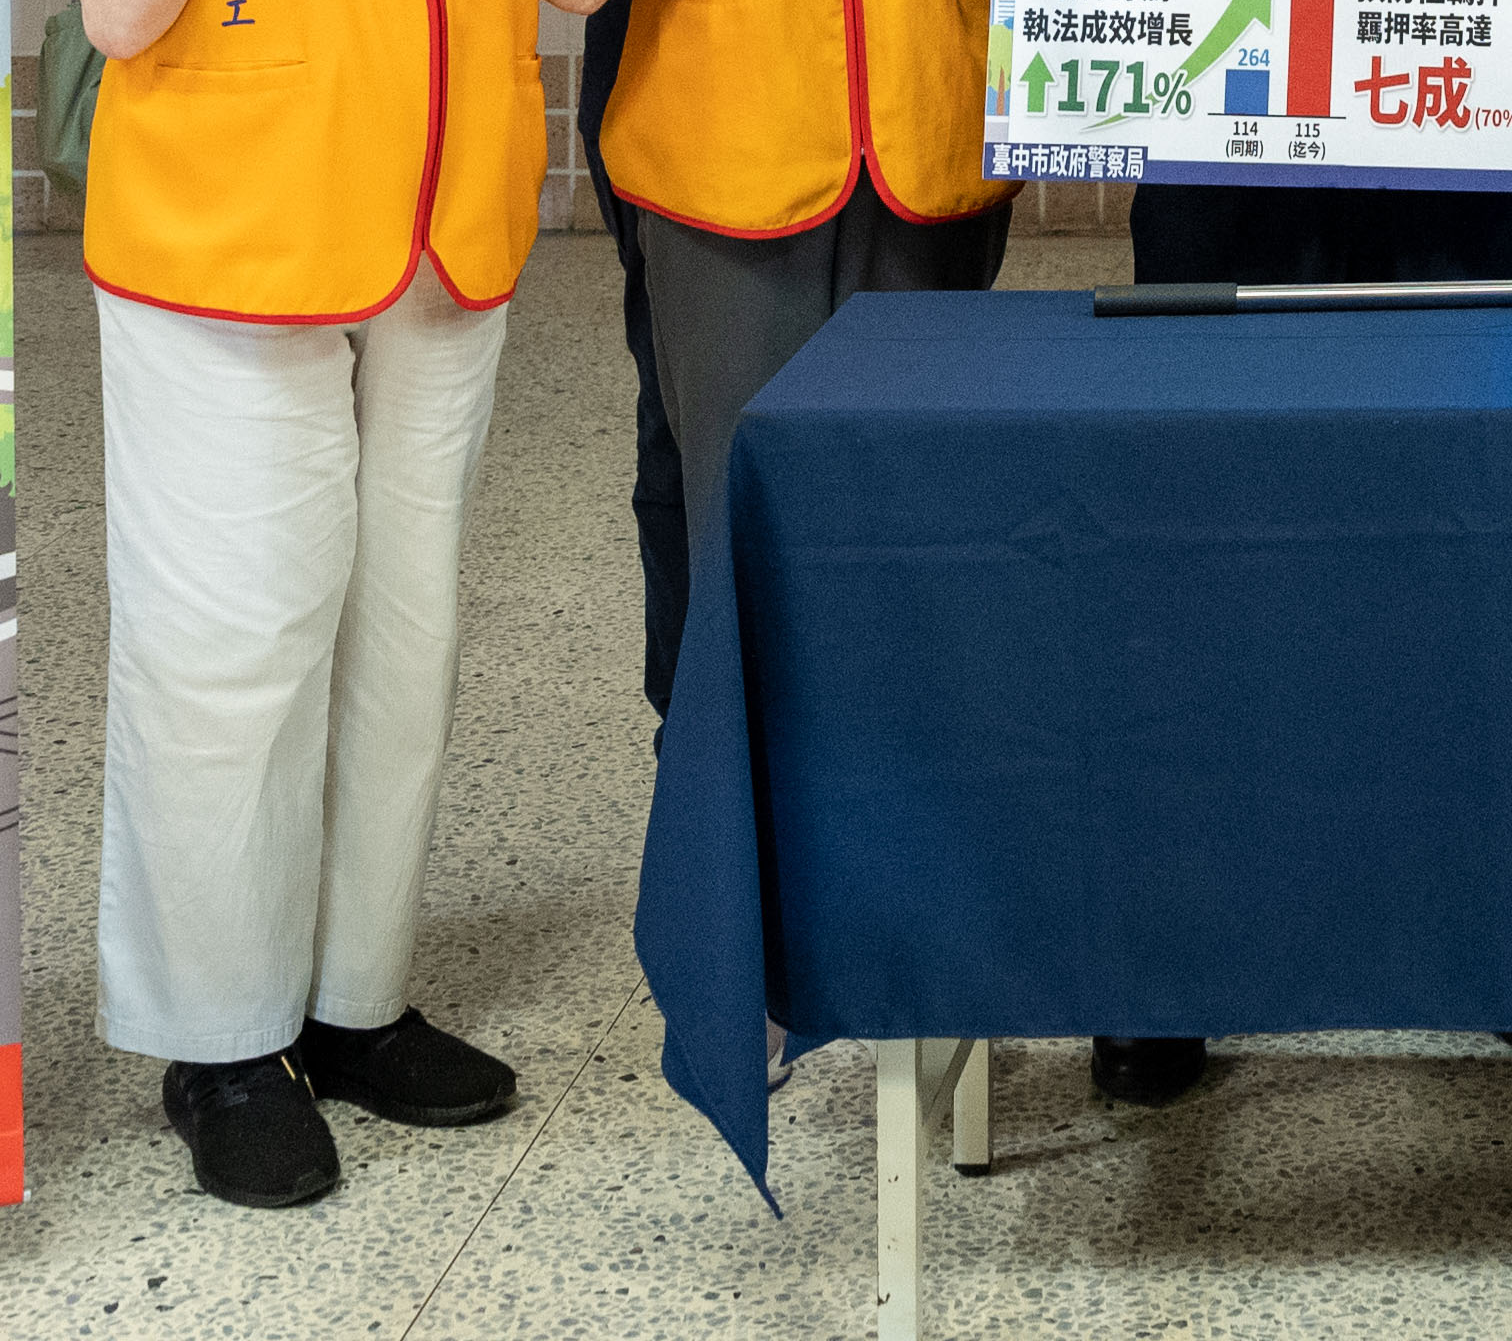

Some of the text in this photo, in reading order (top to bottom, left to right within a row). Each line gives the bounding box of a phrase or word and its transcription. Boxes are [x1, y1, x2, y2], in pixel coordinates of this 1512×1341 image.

[1023, 9, 1193, 46] 執法成效增長
[1357, 11, 1492, 47] 羈押率高達
[1238, 48, 1270, 67] 264
[1057, 58, 1191, 115] 171%
[1354, 56, 1472, 129] 七成
[1233, 121, 1258, 136] 114
[1295, 123, 1320, 138] 115
[992, 144, 1145, 179] 臺中市政府警察局
[1226, 139, 1264, 159] (同期)
[1288, 141, 1326, 161] (迄今)
